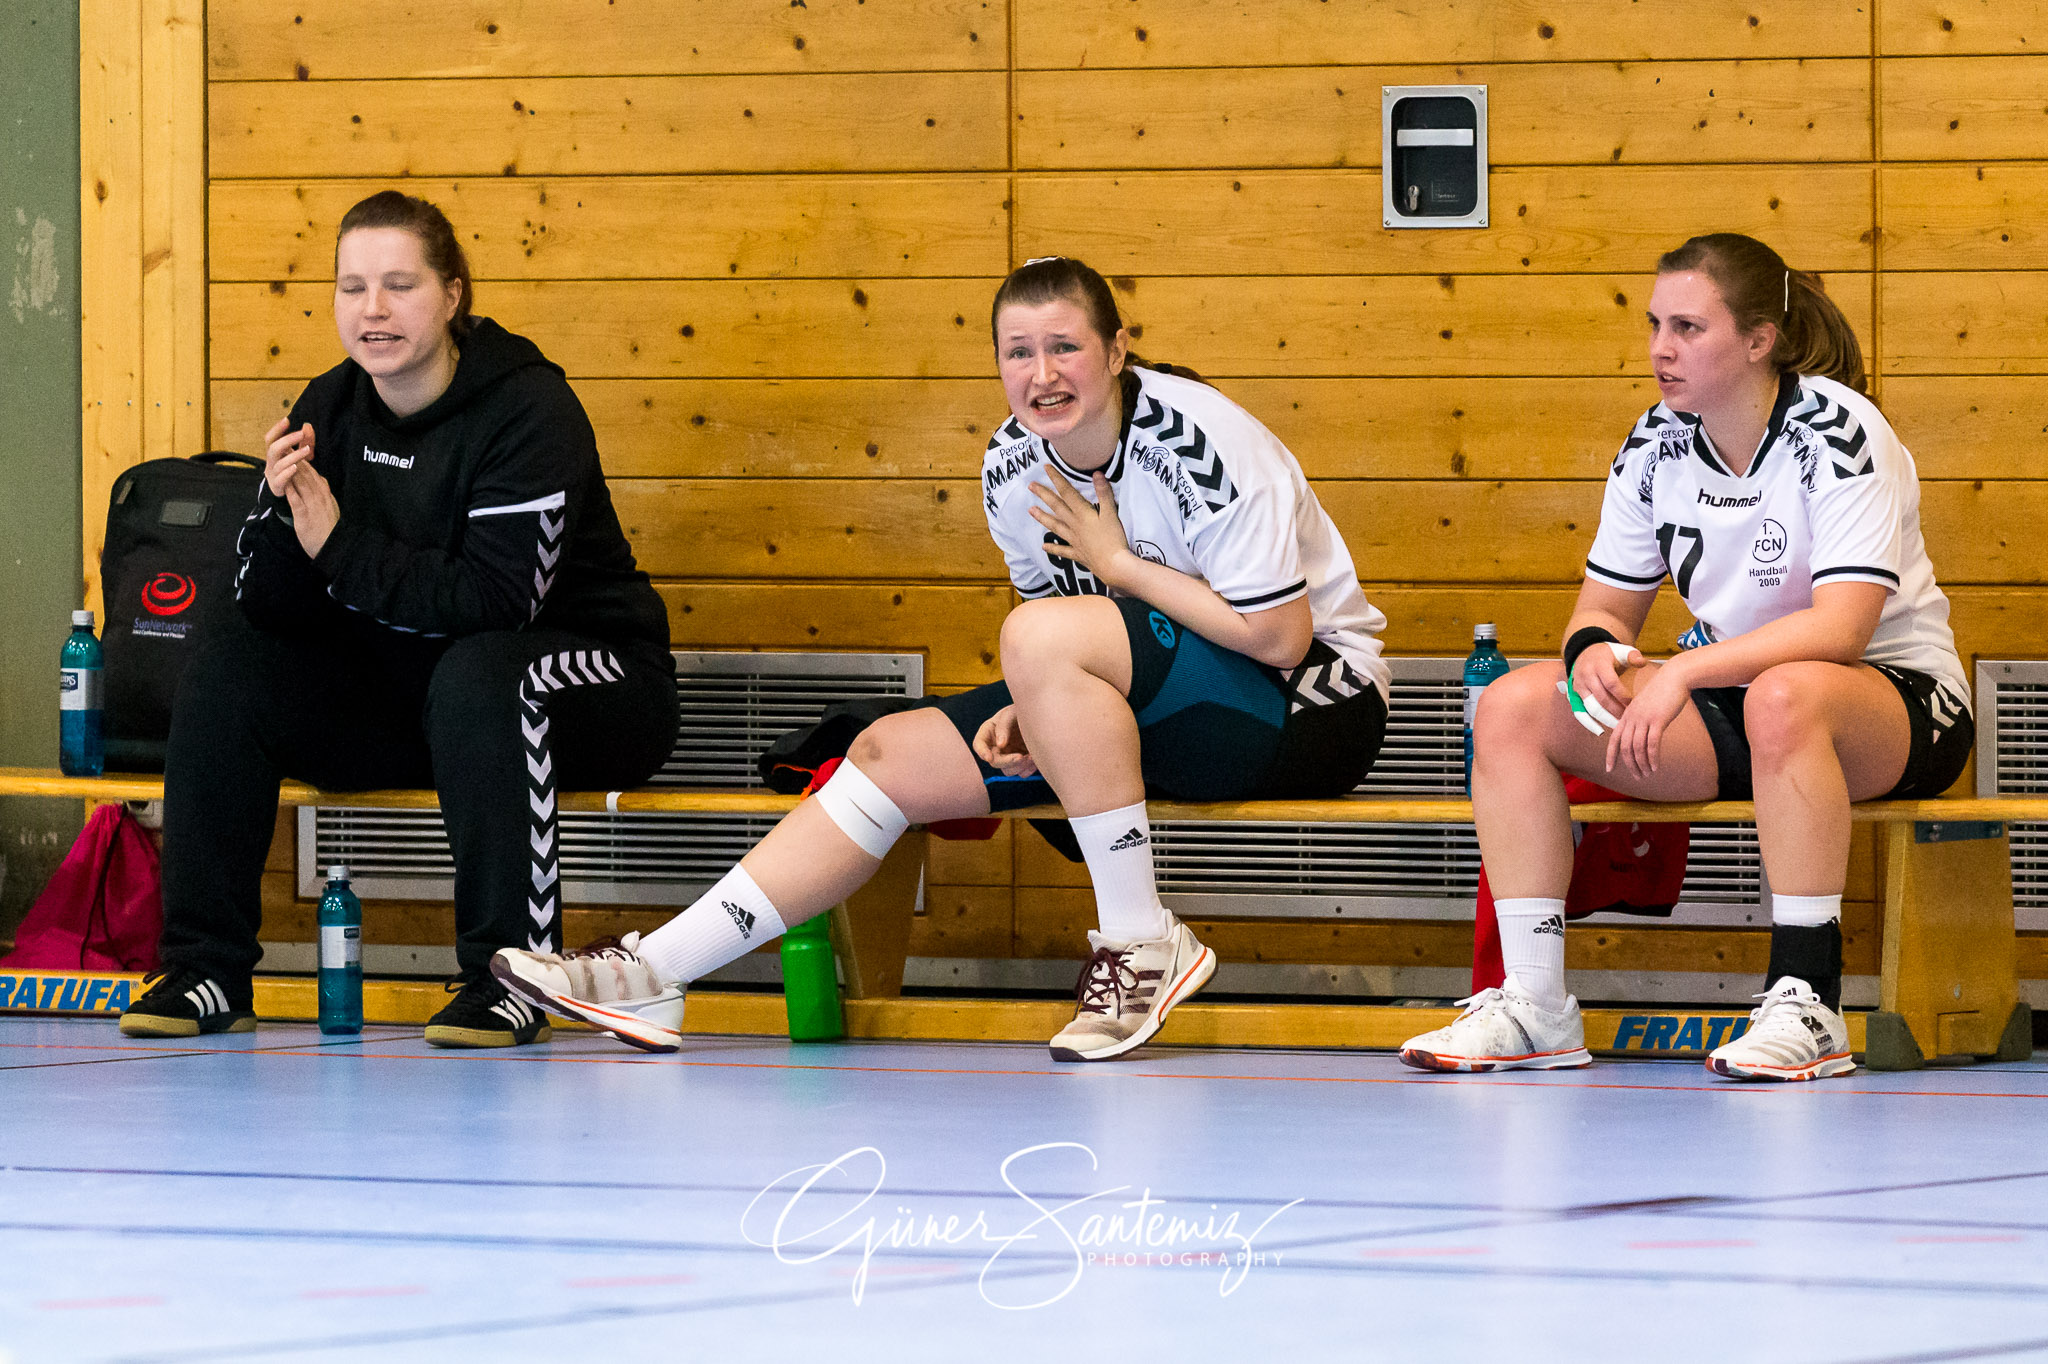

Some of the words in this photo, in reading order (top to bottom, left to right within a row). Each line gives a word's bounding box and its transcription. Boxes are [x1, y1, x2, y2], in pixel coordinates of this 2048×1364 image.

[363, 445, 415, 469] hummel
[1697, 488, 1762, 508] hummel
[1754, 537, 1782, 553] FCN
[1655, 522, 1704, 600] 17
[1749, 565, 1788, 578] Handball
[1758, 577, 1781, 588] 2009
[1109, 836, 1149, 852] adidas
[721, 900, 751, 940] adidas
[1533, 924, 1565, 939] adida
